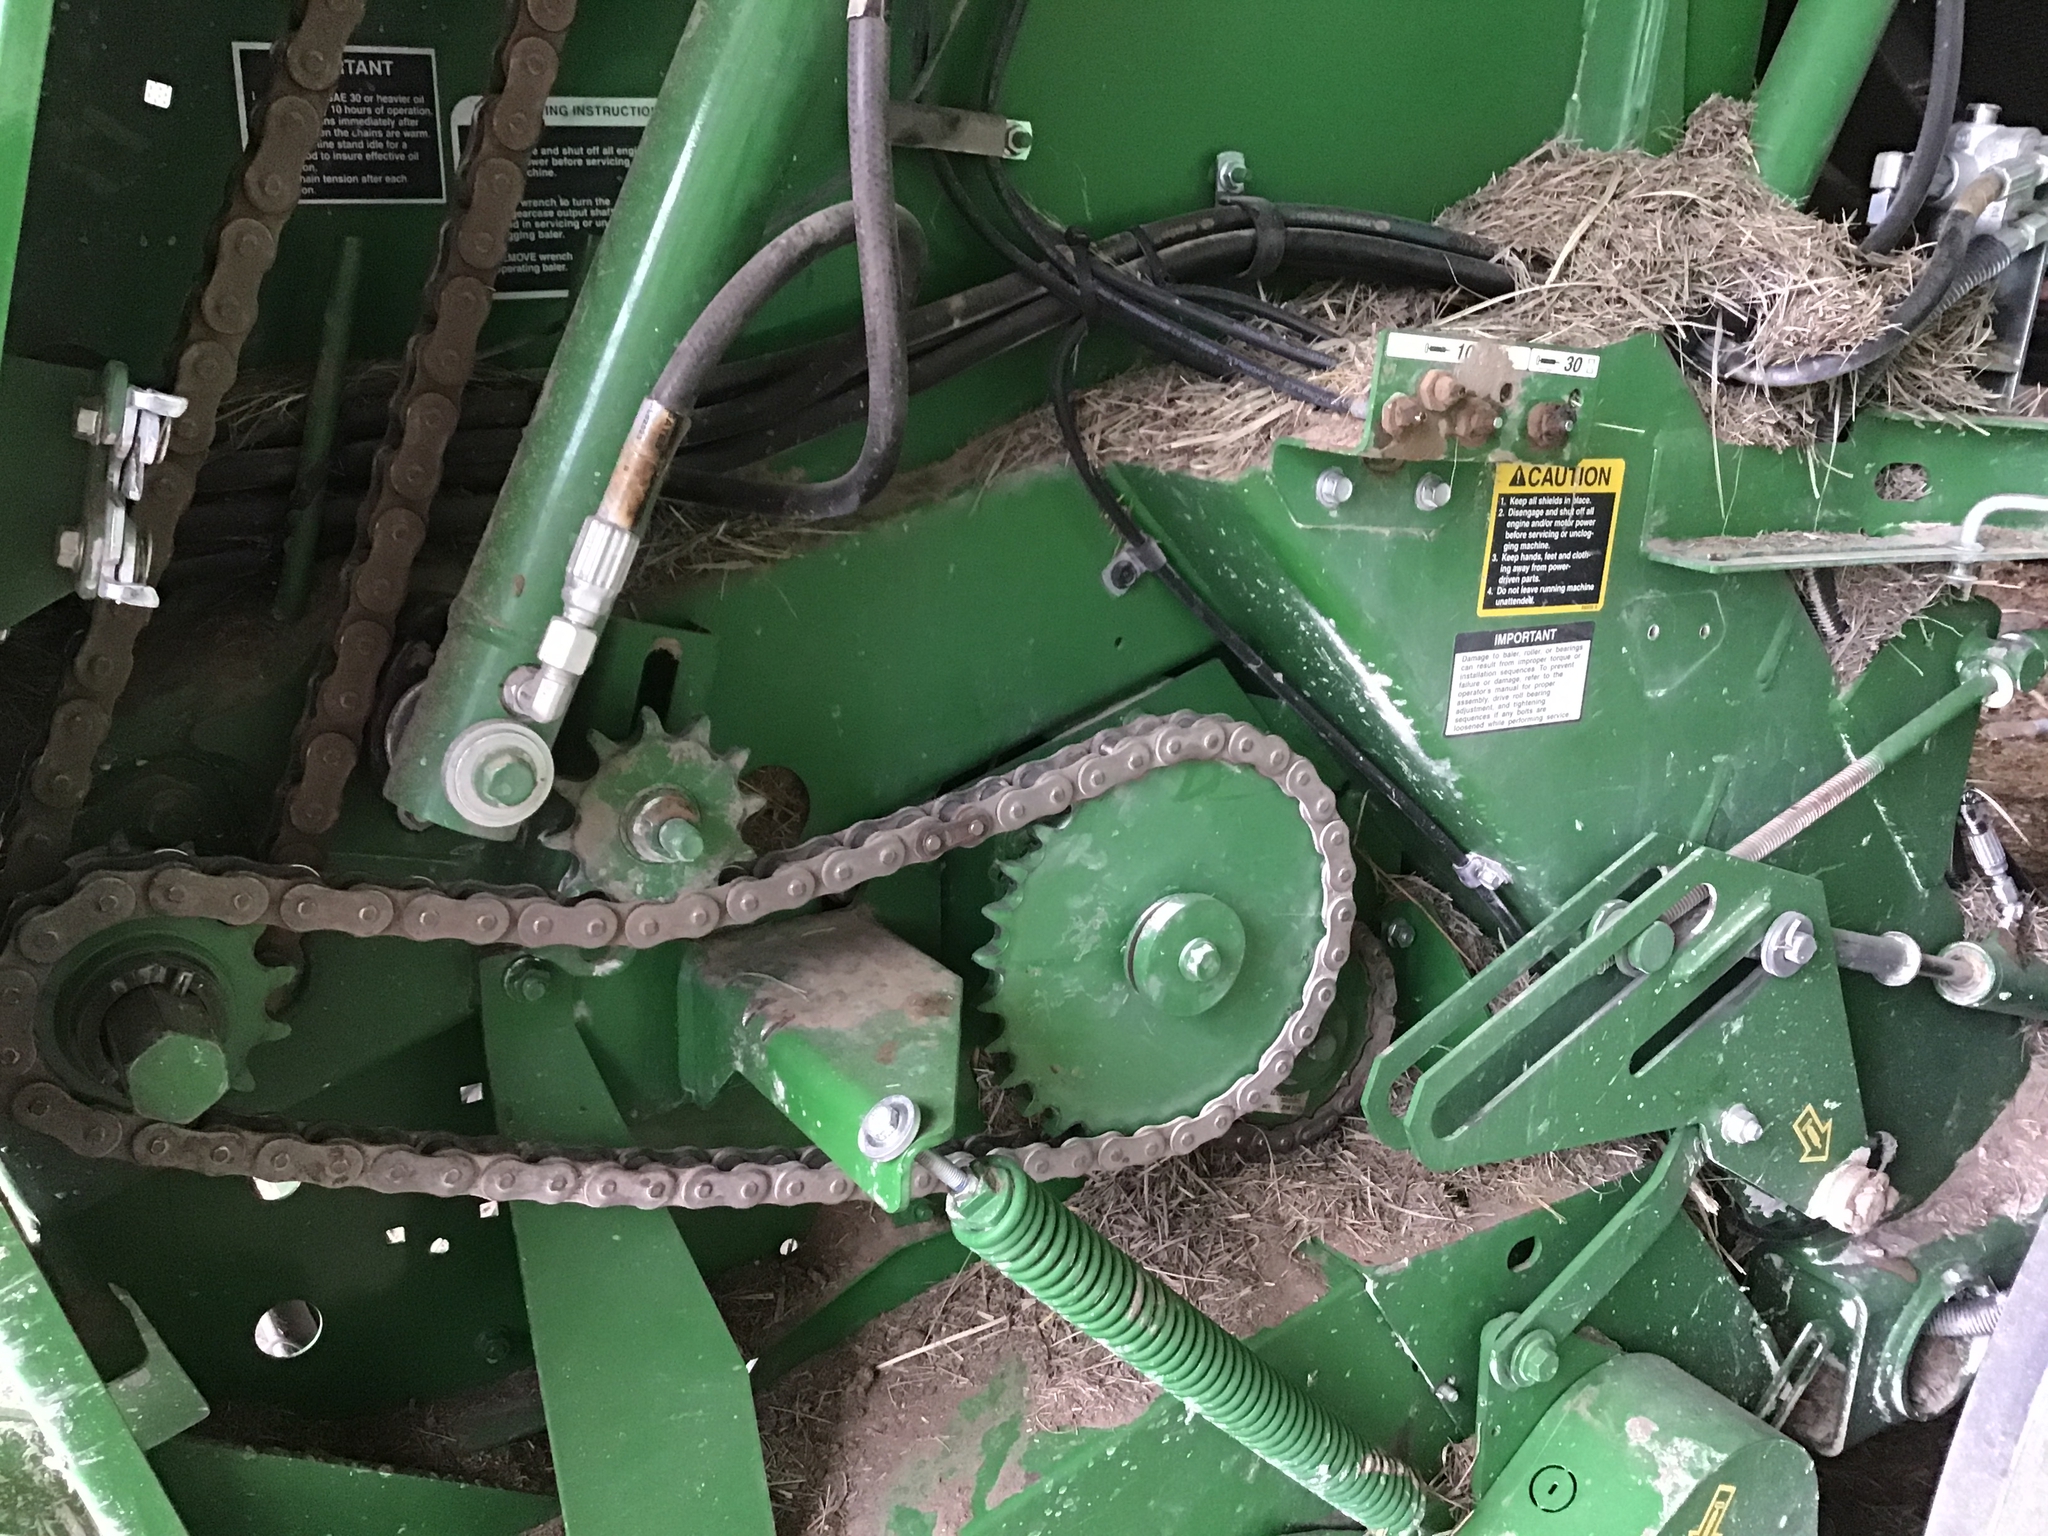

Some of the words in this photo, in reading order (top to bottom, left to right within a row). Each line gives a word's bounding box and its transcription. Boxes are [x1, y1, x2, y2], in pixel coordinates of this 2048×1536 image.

[350, 93, 361, 103] 30
[364, 95, 373, 103] or
[377, 95, 410, 103] heavier
[331, 106, 341, 114] 10
[344, 106, 372, 115] hours
[375, 106, 384, 115] of
[546, 105, 568, 116] ING
[339, 118, 395, 128] immediately
[399, 118, 418, 126] after
[334, 128, 349, 137] the
[352, 129, 383, 137] chains
[367, 141, 383, 149] idle
[386, 141, 398, 149] for
[541, 146, 559, 155] and
[562, 147, 583, 155] shut
[587, 147, 599, 155] off
[603, 147, 613, 155] all
[333, 152, 363, 160] insure
[528, 158, 548, 166] wer
[552, 157, 583, 166] before
[586, 158, 630, 168] servicing
[527, 169, 557, 177] chine.
[323, 175, 358, 183] tension
[362, 175, 382, 183] after
[385, 175, 407, 183] each
[520, 198, 557, 206] wrench
[557, 209, 587, 219] output
[522, 220, 531, 228] in
[535, 219, 579, 230] servicing
[505, 253, 536, 262] MOVE
[539, 252, 573, 260] wrench
[1564, 356, 1582, 372] 30
[1528, 466, 1611, 487] CAUTION
[1501, 498, 1506, 506] 1.
[1510, 498, 1526, 507] Keep
[1538, 497, 1562, 505] shields
[1508, 509, 1544, 519] Disengage
[1545, 508, 1558, 516] and
[1560, 508, 1574, 516] shut
[1586, 507, 1594, 515] all
[1506, 520, 1529, 530] engine
[1554, 519, 1573, 527] motor
[1575, 520, 1596, 528] power
[1505, 531, 1527, 539] before
[1528, 530, 1559, 540] servicing
[1503, 543, 1519, 552] ging
[1520, 542, 1550, 550] machine.
[1492, 554, 1498, 562] 3.
[1502, 554, 1519, 563] Keep
[1521, 553, 1543, 561] hands,
[1500, 565, 1510, 574] ing
[1512, 566, 1530, 574] away
[1548, 564, 1571, 573] power-
[1499, 576, 1519, 584] driven
[1521, 575, 1540, 585] parts.
[1497, 587, 1506, 595] Do
[1540, 585, 1566, 594] running
[1567, 583, 1594, 592] machine
[1494, 629, 1557, 646] IMPORTANT
[1462, 654, 1489, 662] Damage
[1556, 644, 1583, 653] bearings
[1518, 657, 1547, 665] improper
[1550, 654, 1571, 662] torque
[1460, 670, 1496, 680] installation
[1550, 662, 1574, 671] prevent
[1495, 685, 1519, 693] manual
[1534, 681, 1555, 689] proper
[1527, 690, 1551, 698] bearing
[1513, 699, 1546, 709] tightening
[1454, 723, 1485, 731] loosened
[1488, 719, 1505, 727] while
[1508, 715, 1543, 725] performing
[1455, 714, 1490, 724] sequences
